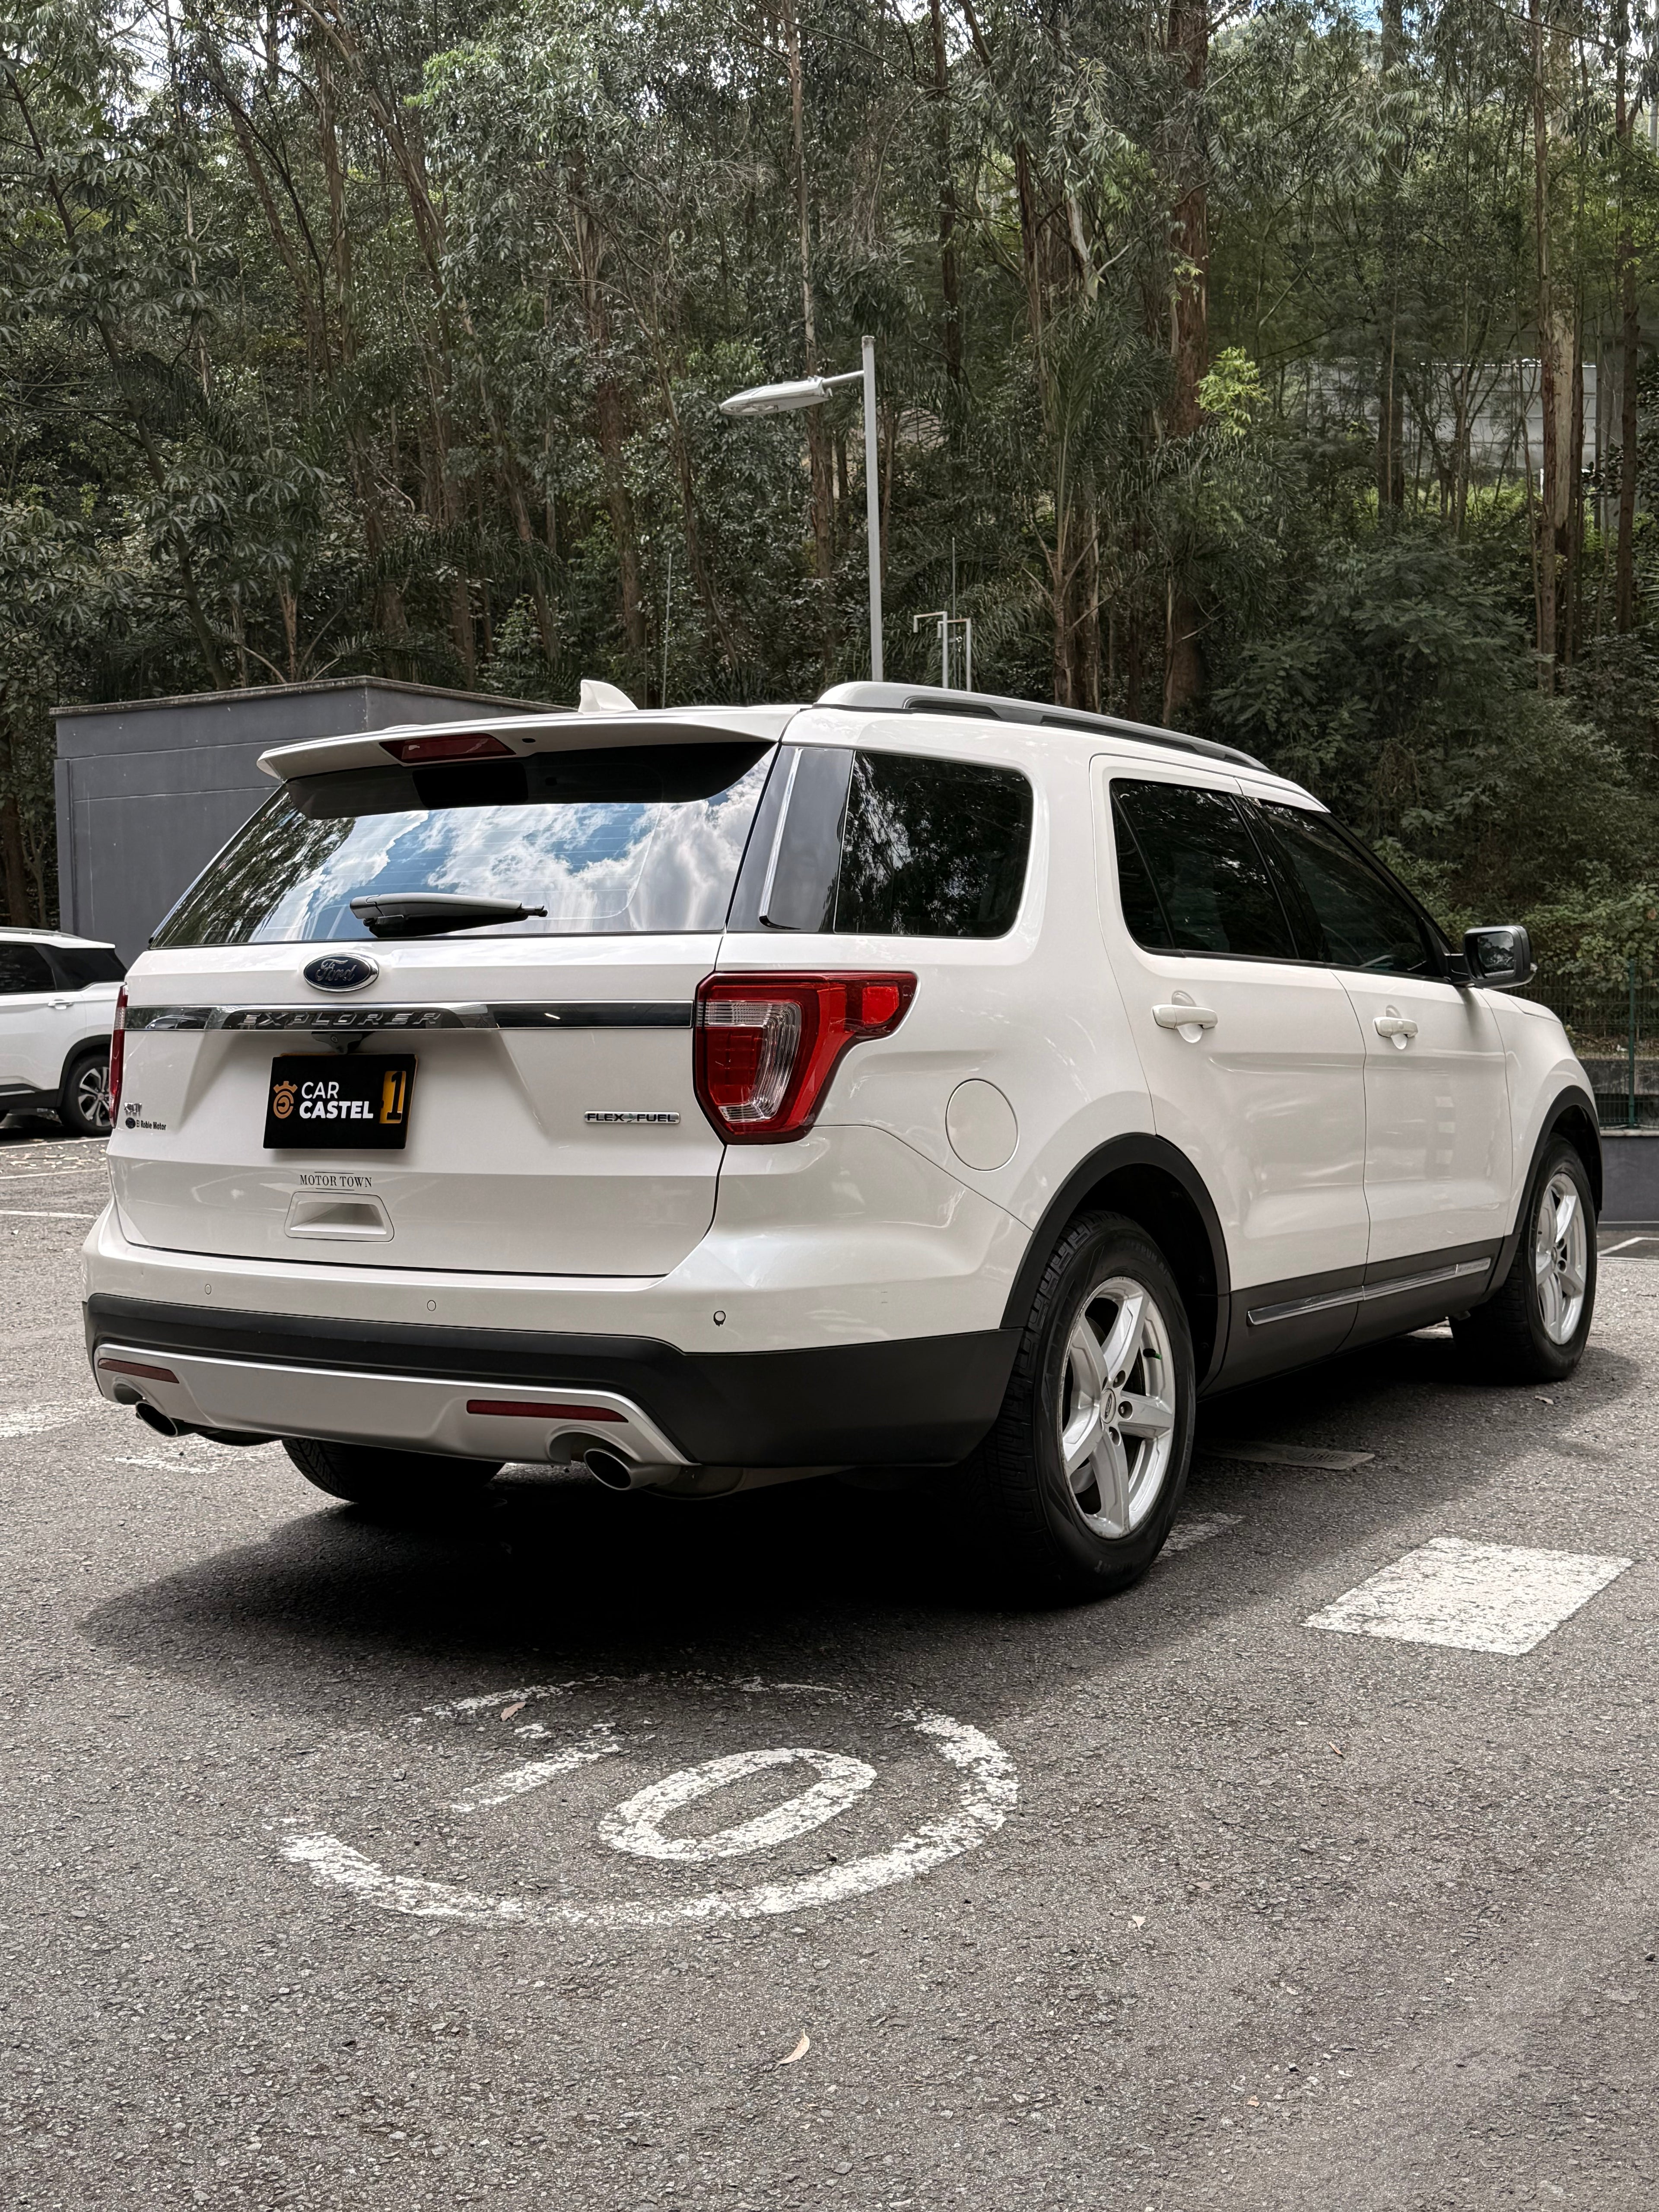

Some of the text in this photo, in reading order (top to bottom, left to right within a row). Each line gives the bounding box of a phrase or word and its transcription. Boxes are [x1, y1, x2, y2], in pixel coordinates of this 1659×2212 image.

[315, 959, 357, 981] Ford
[238, 1012, 441, 1026] EXPLORER
[302, 1081, 339, 1099] CAR
[299, 1101, 374, 1119] CASTEL
[587, 1113, 676, 1122] FLEX FUEL
[153, 1122, 166, 1130] Motor
[300, 1175, 372, 1187] MOTOR TOWN
